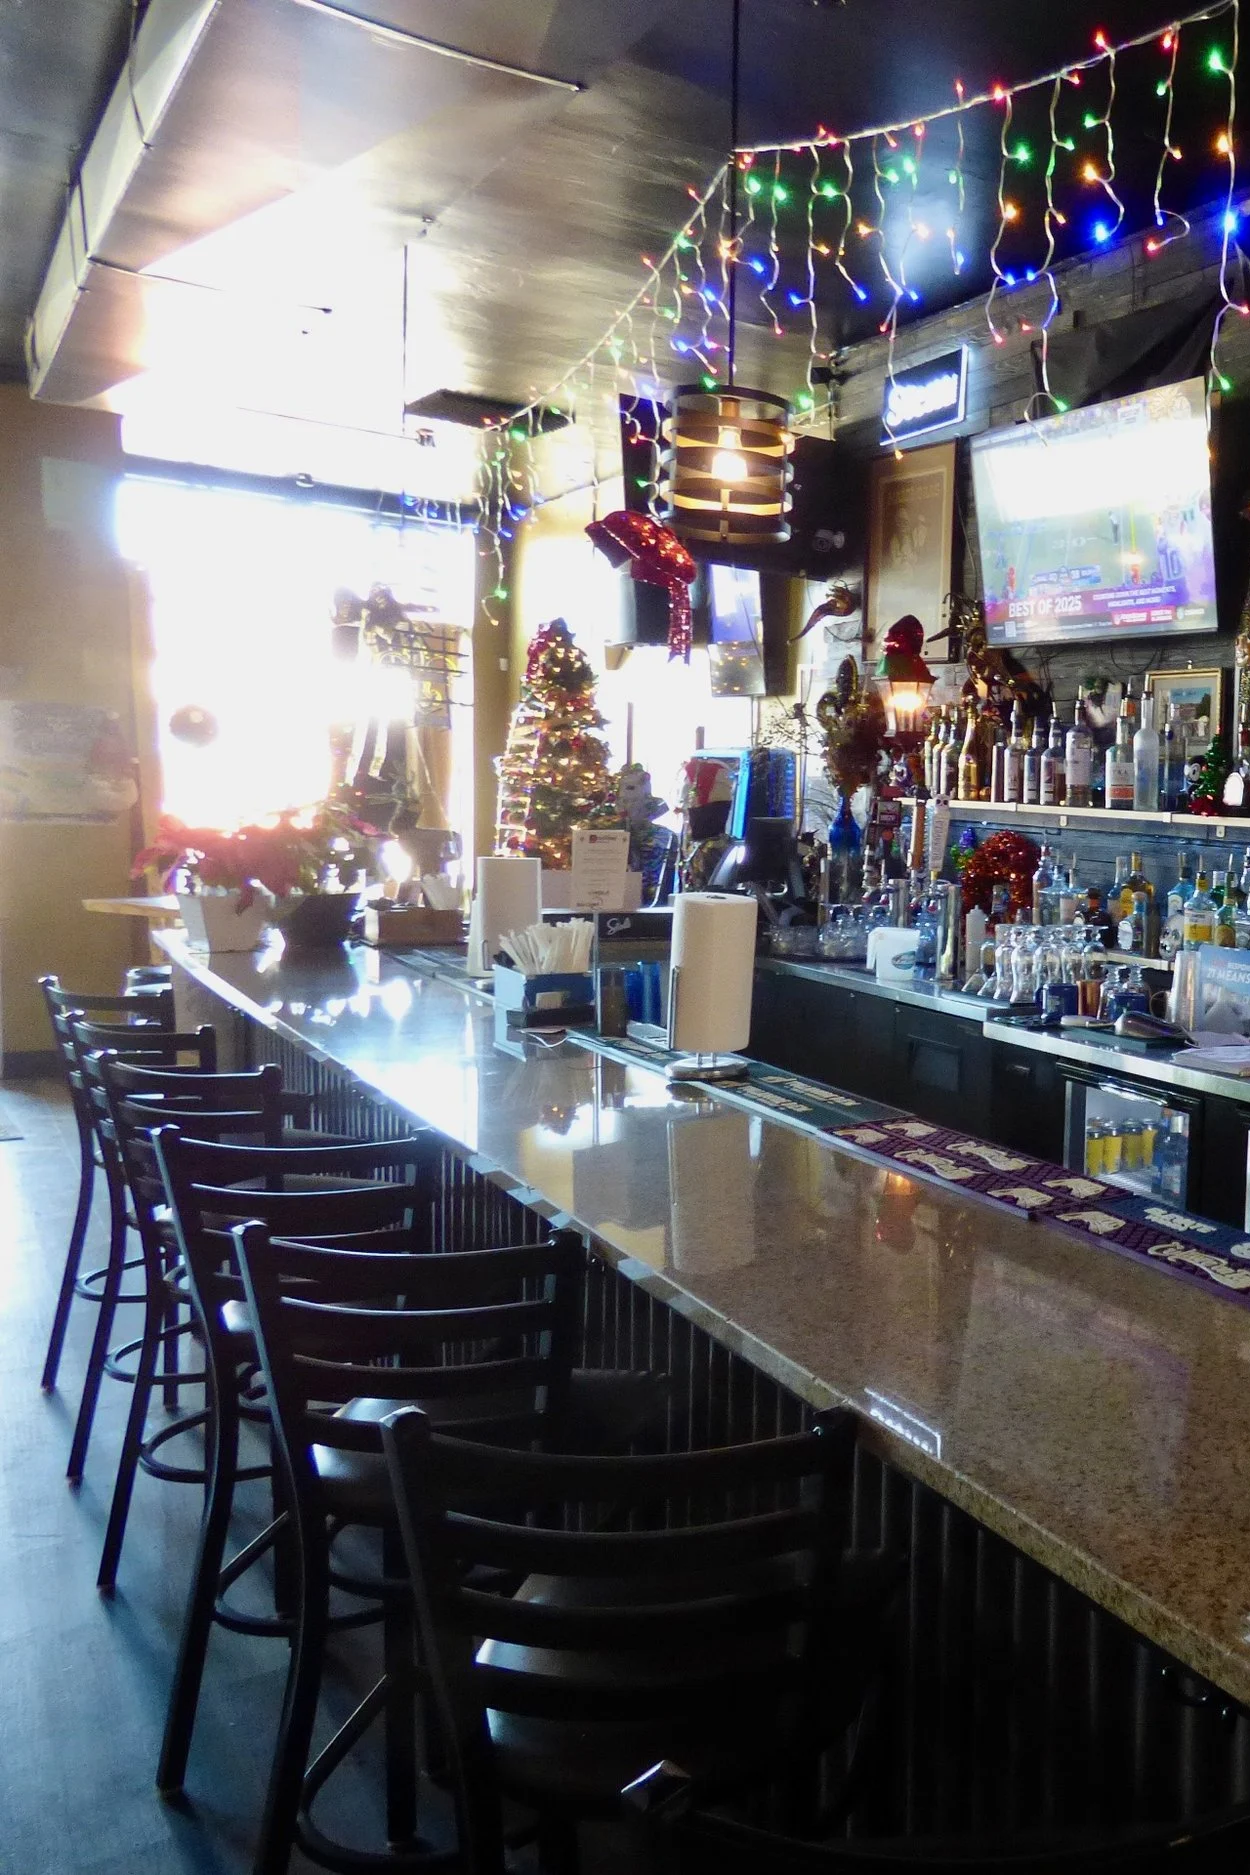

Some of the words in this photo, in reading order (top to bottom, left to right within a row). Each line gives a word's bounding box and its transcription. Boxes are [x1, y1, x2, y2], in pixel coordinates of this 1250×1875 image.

[1008, 600, 1036, 618] BEST
[1037, 598, 1053, 614] OF
[1054, 594, 1082, 613] 2025
